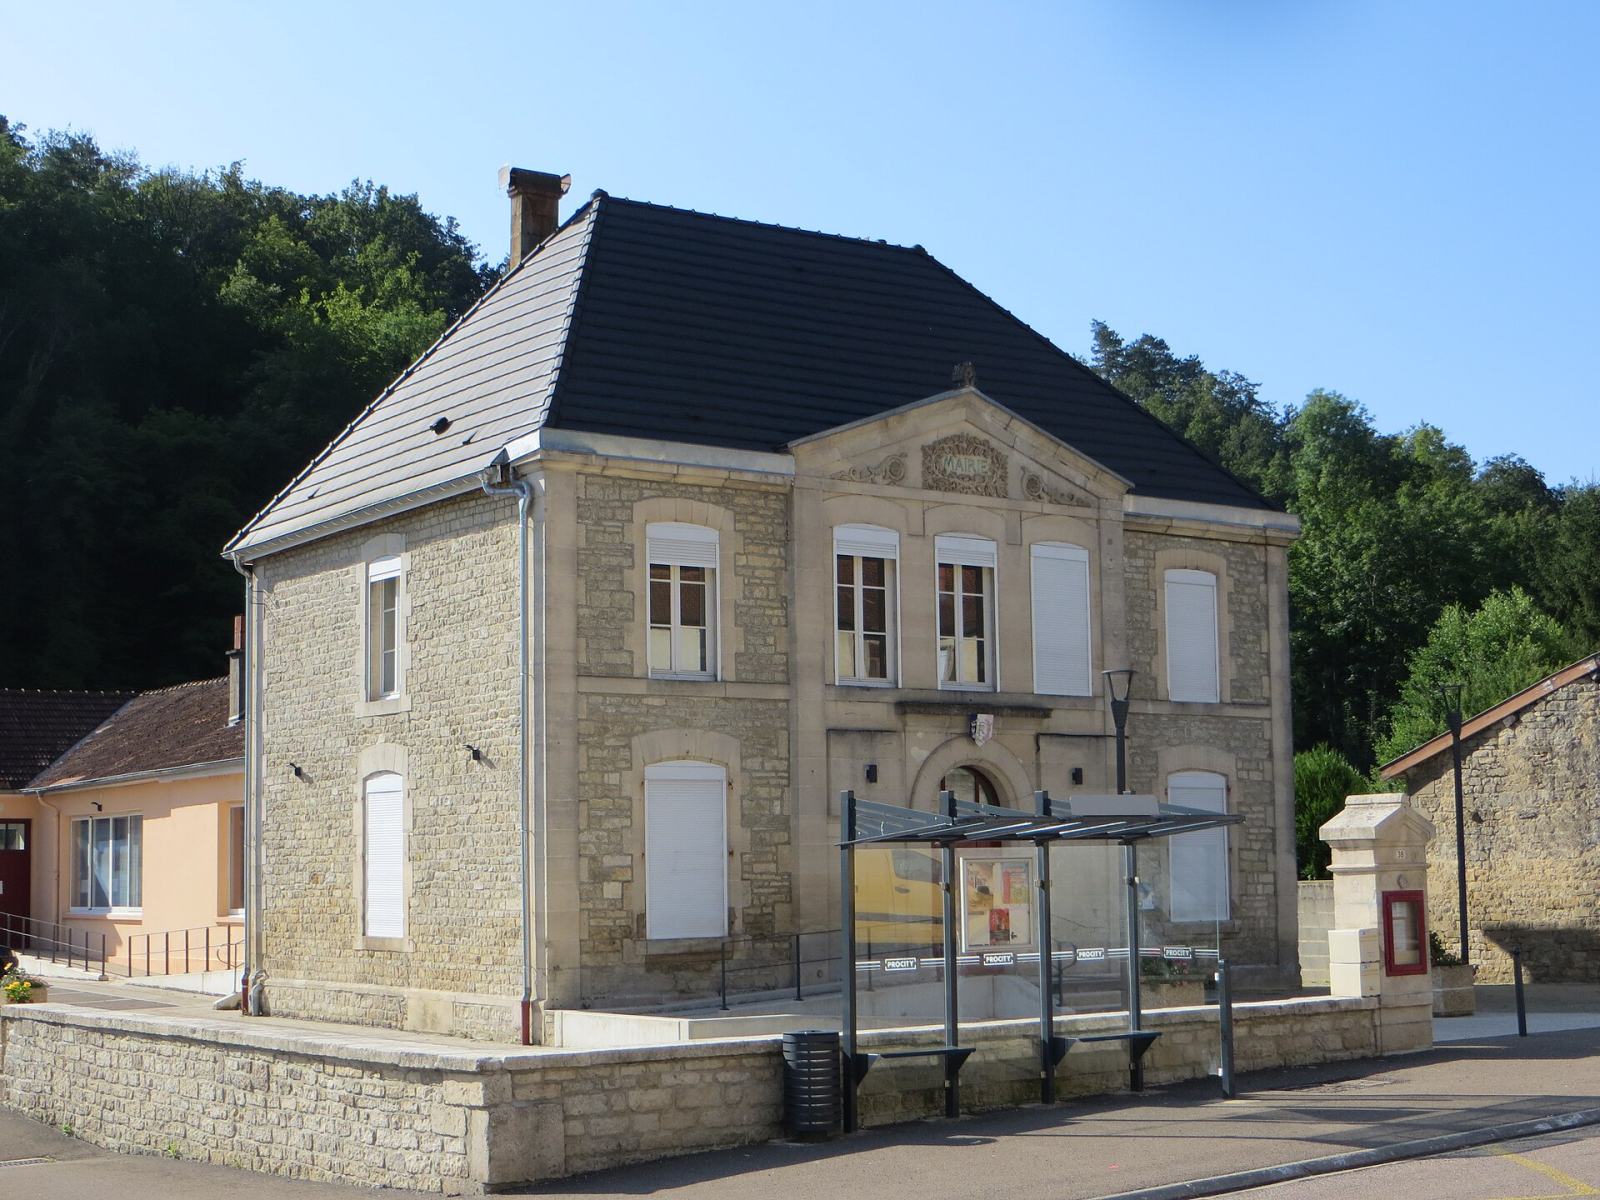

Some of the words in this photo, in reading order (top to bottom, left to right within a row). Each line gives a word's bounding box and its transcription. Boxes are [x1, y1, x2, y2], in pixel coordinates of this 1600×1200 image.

[943, 456, 988, 475] MAIRIE
[1078, 950, 1102, 958] PROCITY
[1165, 949, 1190, 957] PROCITY
[985, 954, 1011, 963] PROCITY
[887, 960, 914, 968] PROCITY
